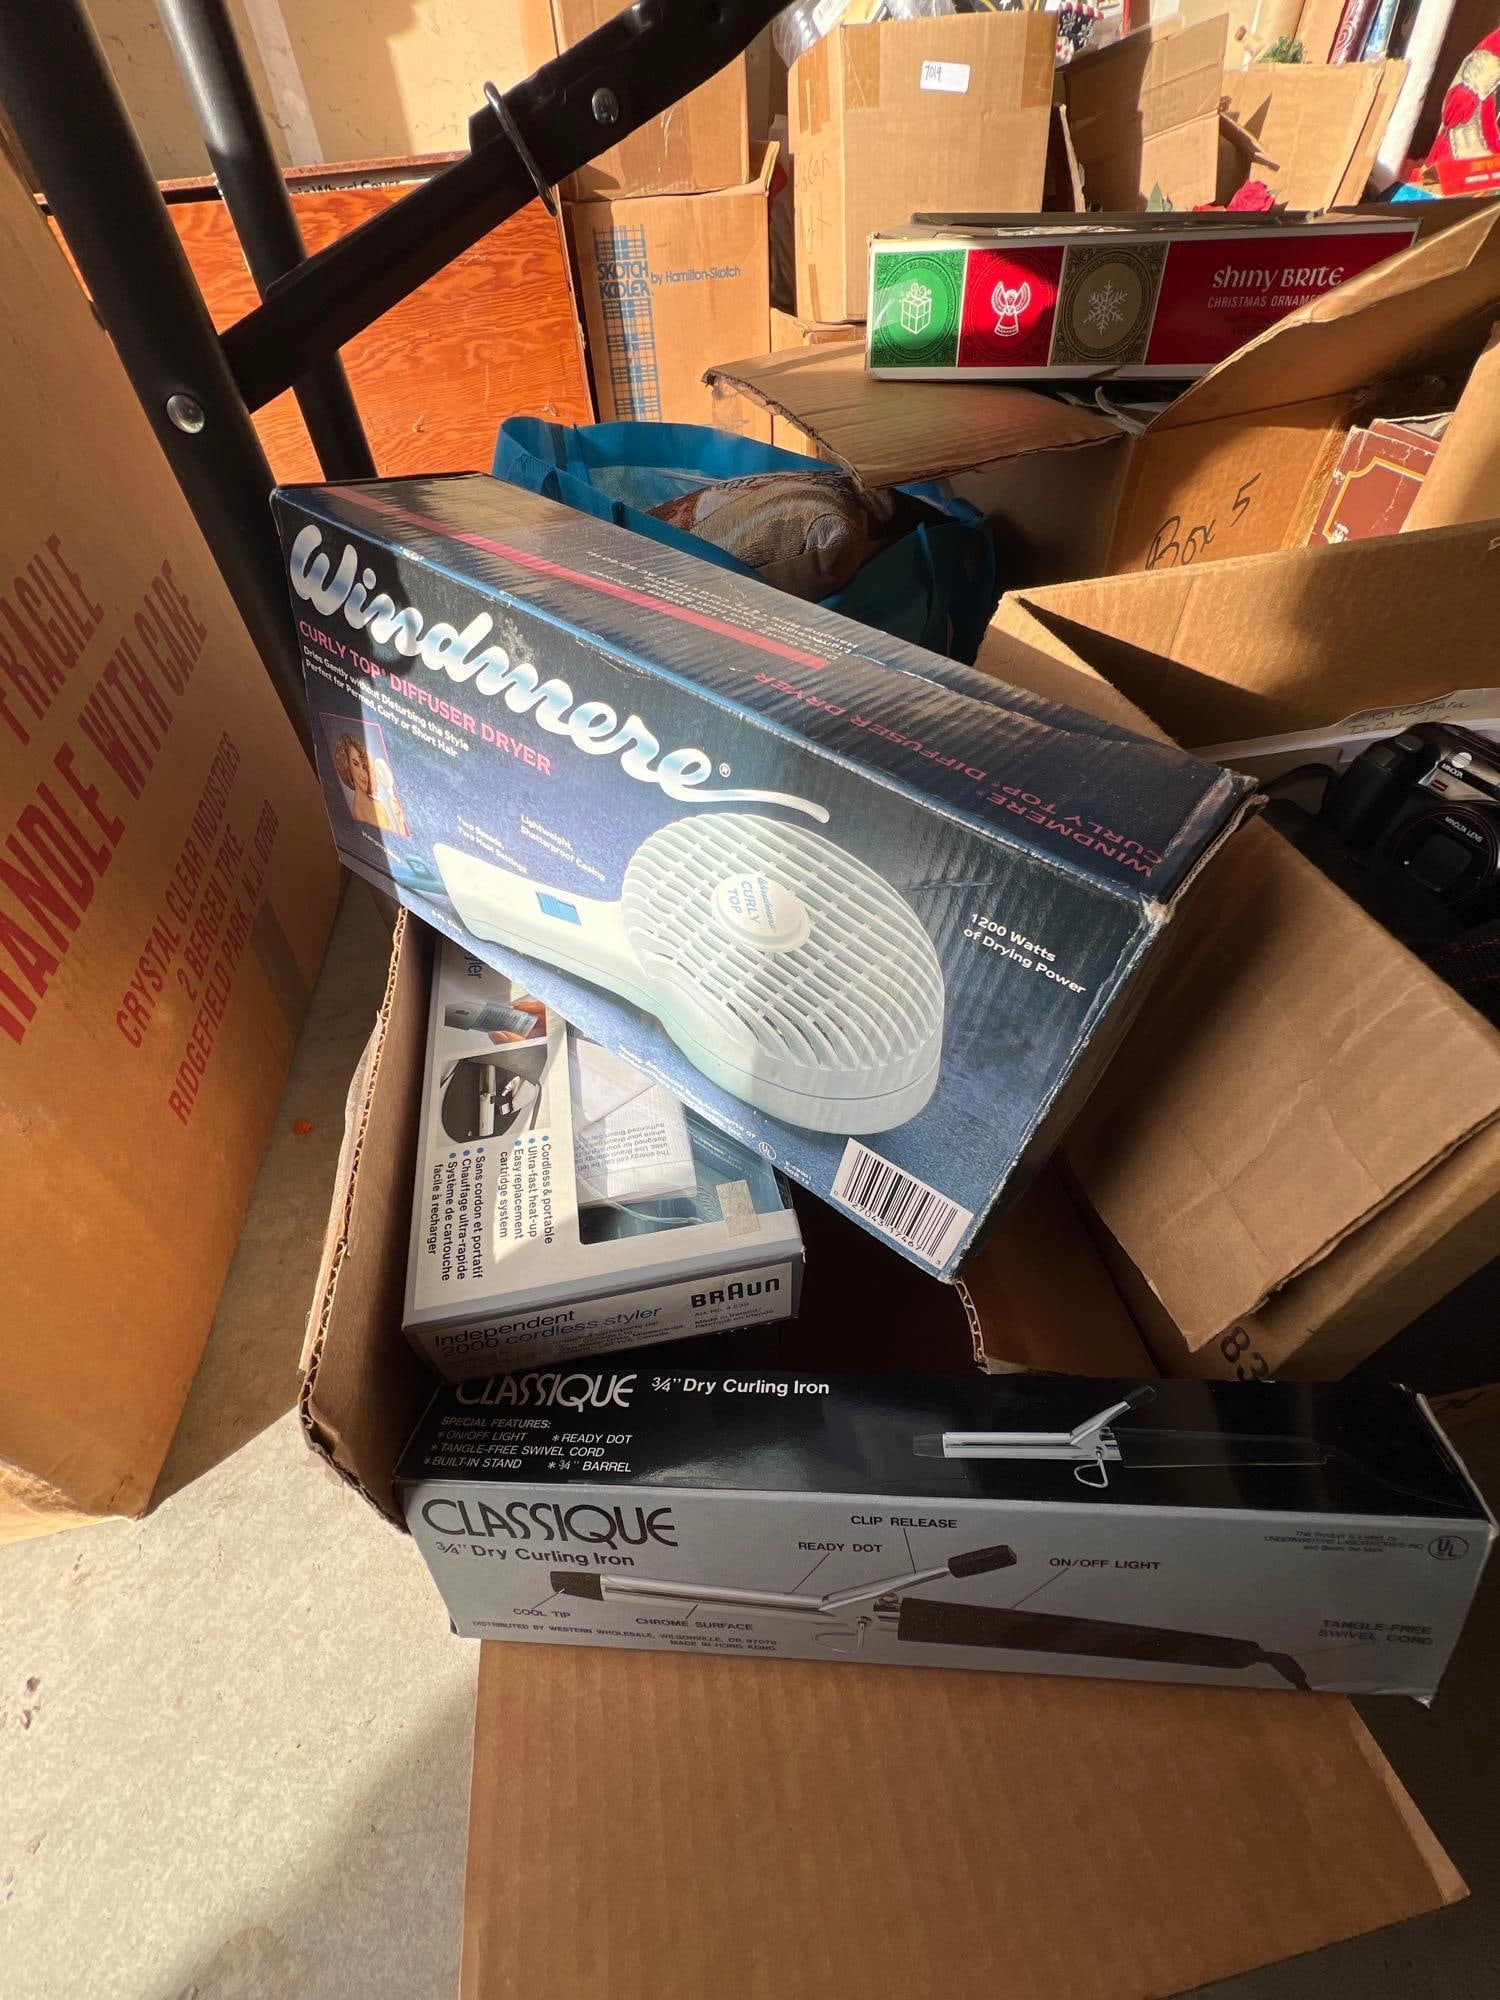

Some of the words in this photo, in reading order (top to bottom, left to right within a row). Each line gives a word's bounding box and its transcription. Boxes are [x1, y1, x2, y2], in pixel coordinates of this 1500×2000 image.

[651, 272, 663, 285] by
[1207, 295, 1268, 309] CHRISTMAS
[1145, 515, 1217, 571] Box
[1230, 472, 1262, 527] 5
[77, 636, 173, 800] WITH
[134, 559, 207, 697] CARE
[299, 620, 347, 660] CURLY
[389, 672, 477, 735] DIFFUSER
[481, 722, 551, 776] DRYER
[303, 645, 323, 664] Dries
[324, 658, 349, 681] Gently
[350, 675, 381, 701] without
[381, 693, 431, 728] Disturbing
[428, 718, 443, 737] the
[445, 730, 469, 752] Style
[752, 671, 847, 718] DRYER
[305, 658, 332, 682] Perfect
[333, 676, 345, 690] for
[377, 704, 399, 726] Curly
[401, 719, 410, 731] or
[412, 725, 436, 748] Short
[438, 741, 458, 758] Hair
[848, 713, 988, 782] DIFFUSER
[1441, 763, 1464, 779] MINOLTA
[457, 815, 474, 832] Two
[1063, 814, 1164, 865] CURLY
[1445, 816, 1468, 833] MINOLTA
[1467, 828, 1484, 844] LENS
[457, 826, 475, 842] Two
[495, 848, 528, 874] Settings
[520, 825, 575, 862] Shatterproof
[576, 858, 606, 882] Casing
[116, 914, 181, 1049] CRYSTAL
[165, 837, 206, 925] CLEAR
[192, 730, 240, 855] INDUSTRIES
[728, 888, 742, 914] TOP
[741, 880, 761, 925] CURLY
[184, 874, 228, 982] BERGEN
[971, 913, 1007, 937] 1200
[1010, 931, 1056, 962] Watts
[963, 928, 981, 941] of
[982, 936, 1033, 968] Drying
[1035, 962, 1086, 994] Power
[177, 967, 198, 1003] 2
[168, 960, 231, 1126] RIDGEFIELD
[432, 1163, 444, 1192] facile
[475, 1155, 486, 1181] Sans
[497, 1151, 510, 1197] cartridge
[513, 1148, 524, 1173] Easy
[527, 1145, 538, 1195] Ultra-fast
[541, 1143, 552, 1189] Cordless
[445, 1161, 458, 1206] Système
[458, 1158, 472, 1212] Chauffage
[474, 1182, 485, 1216] cordon
[444, 1206, 455, 1221] de
[474, 1217, 483, 1233] et
[498, 1197, 510, 1238] system
[514, 1172, 524, 1240] replacement
[527, 1194, 538, 1238] heat-up
[541, 1197, 553, 1244] portable
[852, 1201, 884, 1227] 27043
[890, 1227, 922, 1251] 17467
[426, 1201, 439, 1256] recharger
[456, 1212, 470, 1280] ultra-rapide
[441, 1222, 453, 1281] cartouche
[471, 1233, 483, 1279] portatif
[435, 1309, 576, 1347] Independent
[441, 1336, 499, 1358] 2000
[504, 1320, 600, 1345] cordless
[601, 1306, 664, 1328] styler
[456, 1373, 638, 1413] CLASSIQUE
[683, 1378, 717, 1395] Dry
[722, 1378, 789, 1397] Curling
[793, 1380, 830, 1395] Iron
[441, 1416, 487, 1427] SPECIAL
[490, 1418, 552, 1429] FEATURES:
[446, 1430, 491, 1441] ON/OFF
[492, 1431, 528, 1442] LIGHT
[561, 1433, 603, 1444] READY
[606, 1434, 633, 1444] DOT
[432, 1456, 480, 1468] BUILT-IN
[481, 1458, 523, 1469] STAND
[582, 1462, 632, 1473] BARREL
[440, 1443, 517, 1456] TANGLE-FREE
[521, 1445, 565, 1457] SWIVEL
[569, 1447, 606, 1458] CORD
[421, 1498, 680, 1551] CLASSIQUE
[850, 1515, 883, 1525] CLIP
[890, 1517, 958, 1529] RELEASE
[471, 1544, 507, 1561] Dry
[514, 1547, 589, 1567] Curling
[595, 1552, 635, 1566] Iron
[798, 1541, 845, 1552] READY
[852, 1543, 883, 1553] DOT
[1049, 1557, 1109, 1569] ON/OFF
[1114, 1559, 1162, 1571] LIGHT
[472, 1620, 529, 1631] DISTRIBUTED
[548, 1625, 593, 1635] WESTERN
[513, 1608, 548, 1618] COOL
[552, 1610, 571, 1619] TIP
[635, 1617, 689, 1628] CHROME
[695, 1621, 753, 1631] SURFACE
[1321, 1619, 1433, 1635] TANGLE-FREE
[1317, 1629, 1377, 1641] SWIVEL
[1386, 1634, 1434, 1645] CORD
